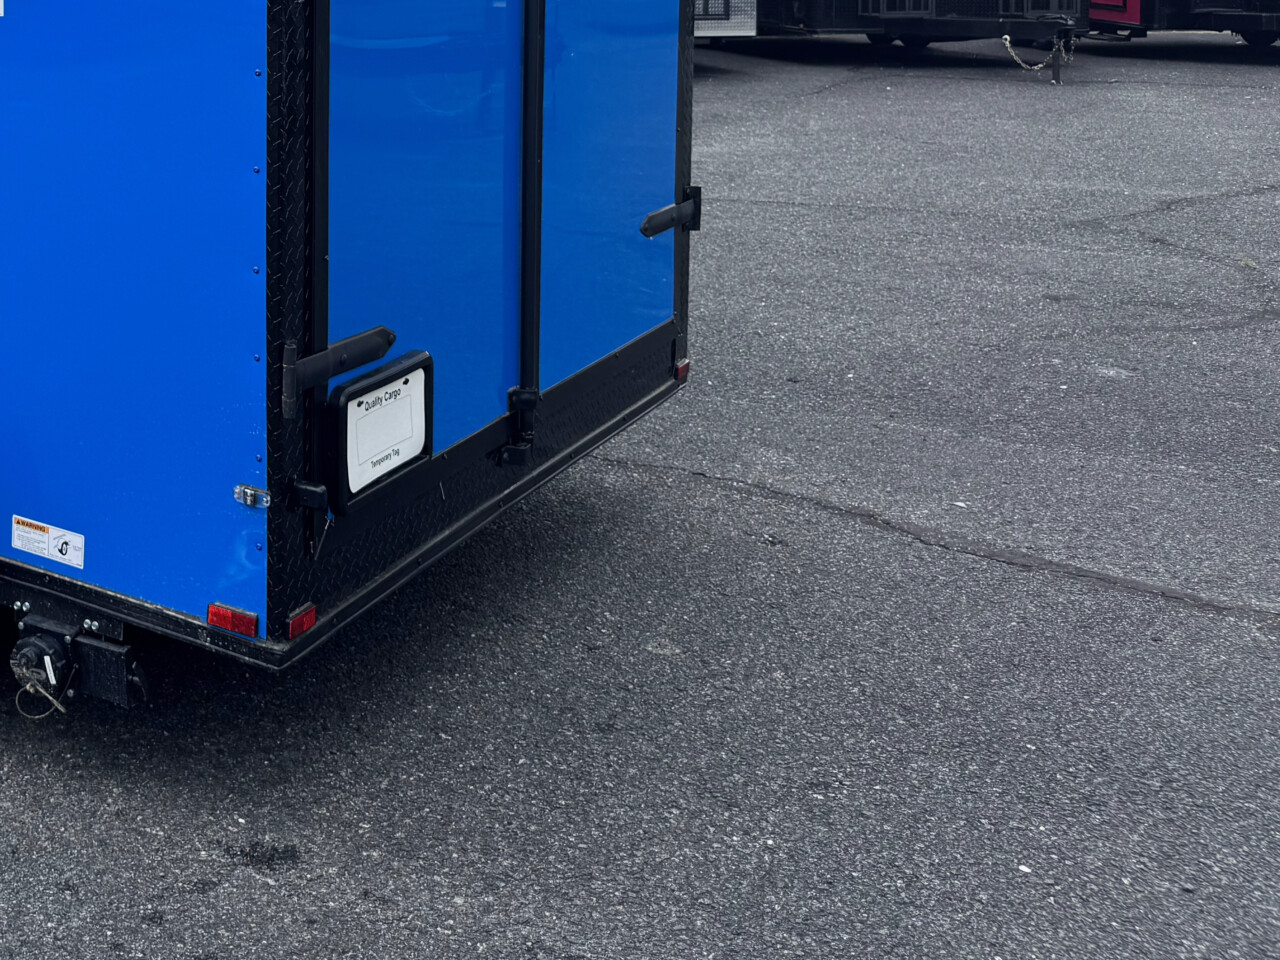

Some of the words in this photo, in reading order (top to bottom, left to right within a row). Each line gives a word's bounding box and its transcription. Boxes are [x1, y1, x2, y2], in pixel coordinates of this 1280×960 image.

[364, 395, 383, 412] Quality
[383, 387, 401, 402] Cargo
[370, 452, 392, 469] Temporary
[391, 447, 400, 460] Tag
[20, 519, 45, 533] WARNING
